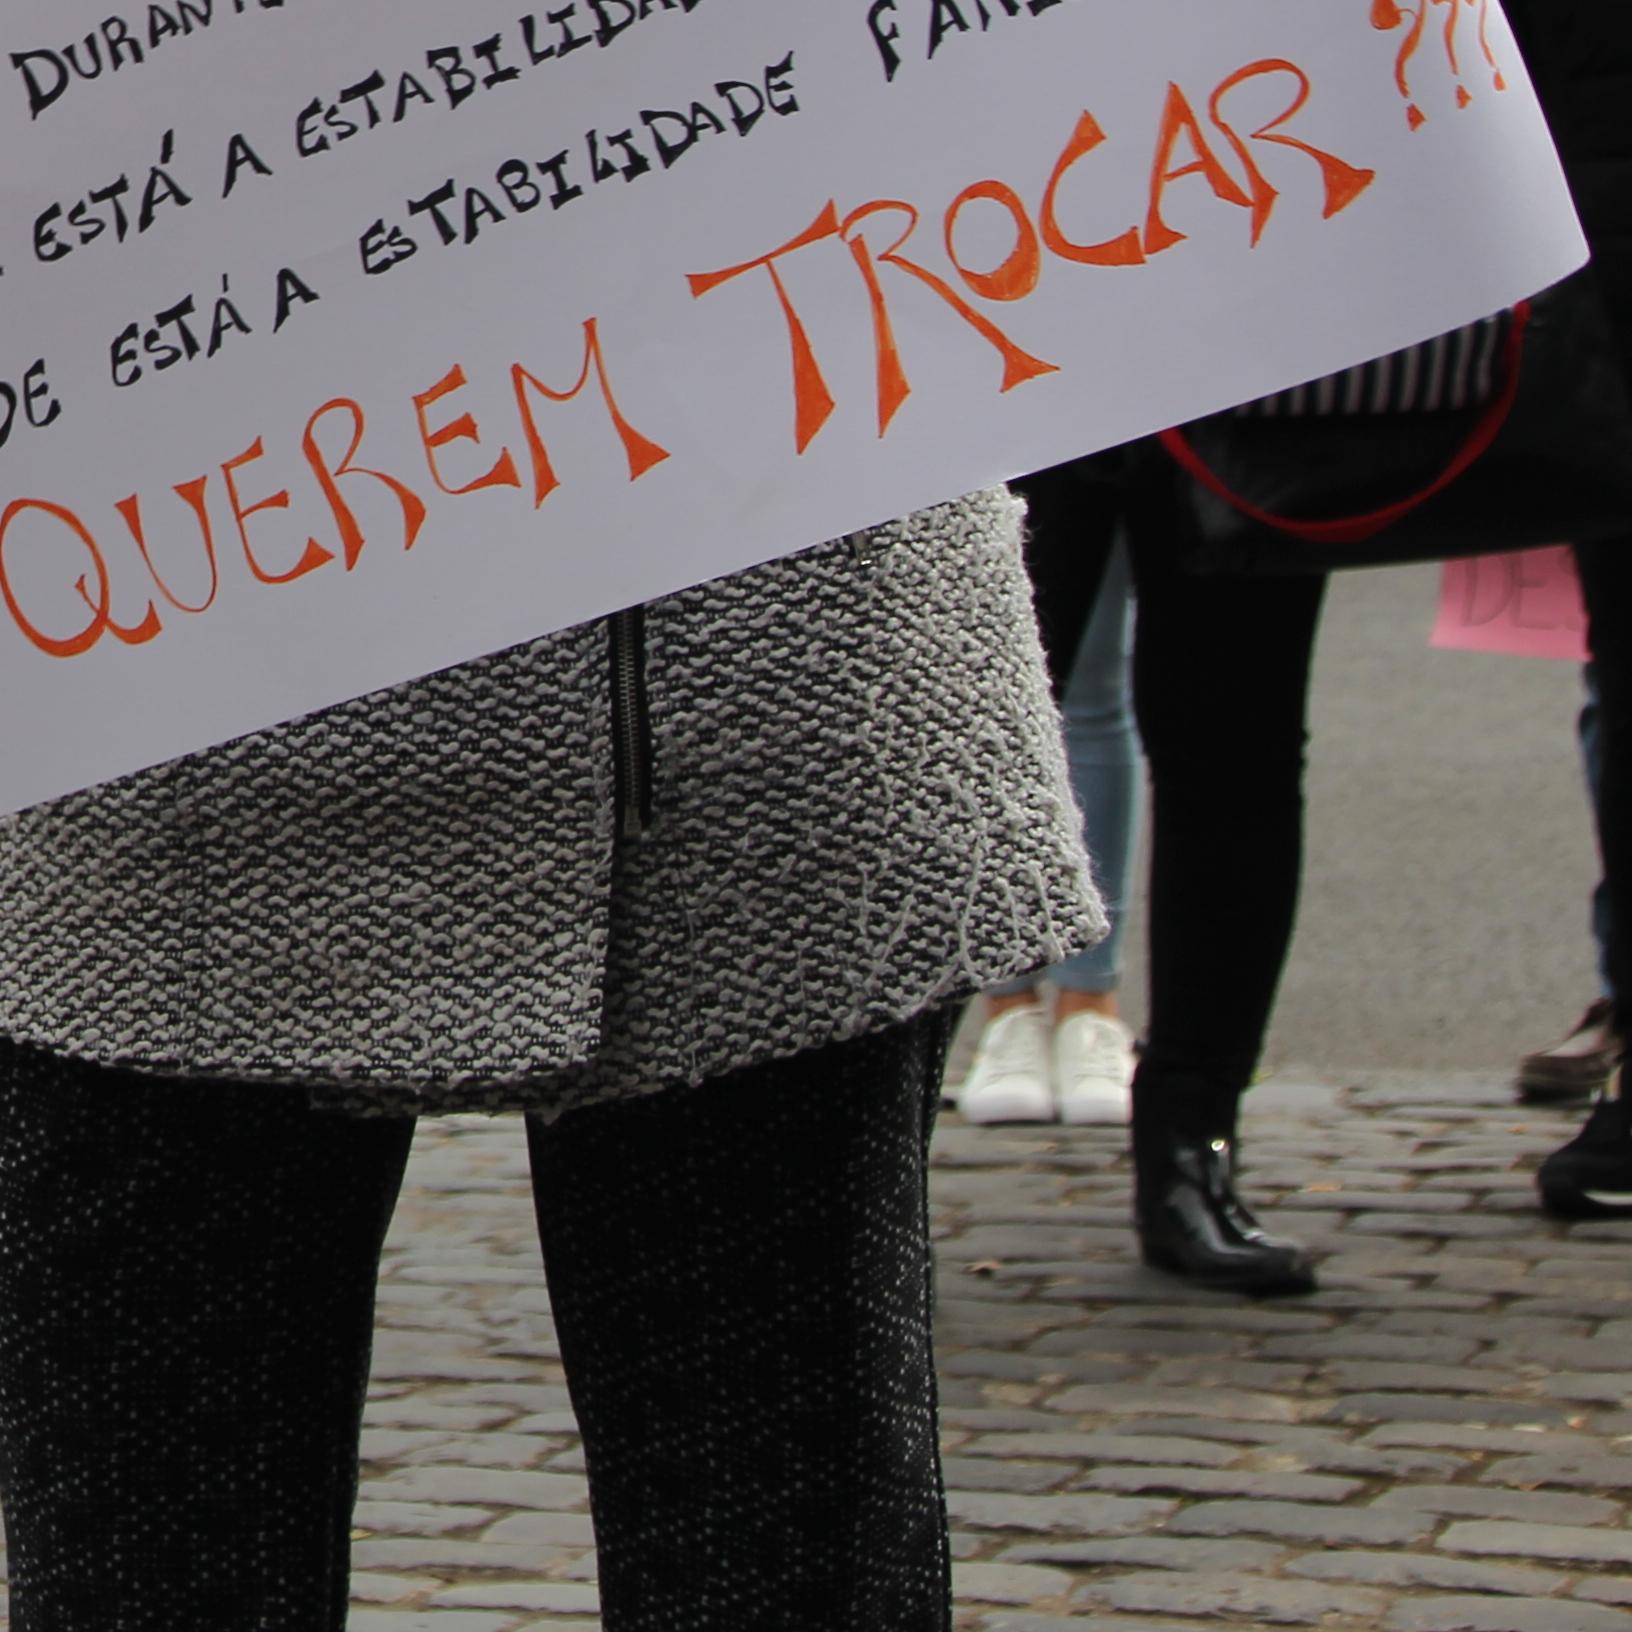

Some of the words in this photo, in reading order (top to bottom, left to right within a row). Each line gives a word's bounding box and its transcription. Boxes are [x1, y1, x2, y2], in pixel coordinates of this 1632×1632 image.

[33, 128, 191, 264] ESTÁ
[220, 132, 275, 199] A
[108, 274, 252, 389] ESTÁ
[272, 266, 320, 333] A
[360, 50, 801, 276] ESTABILIDADE
[684, 57, 1376, 456] TROCAR
